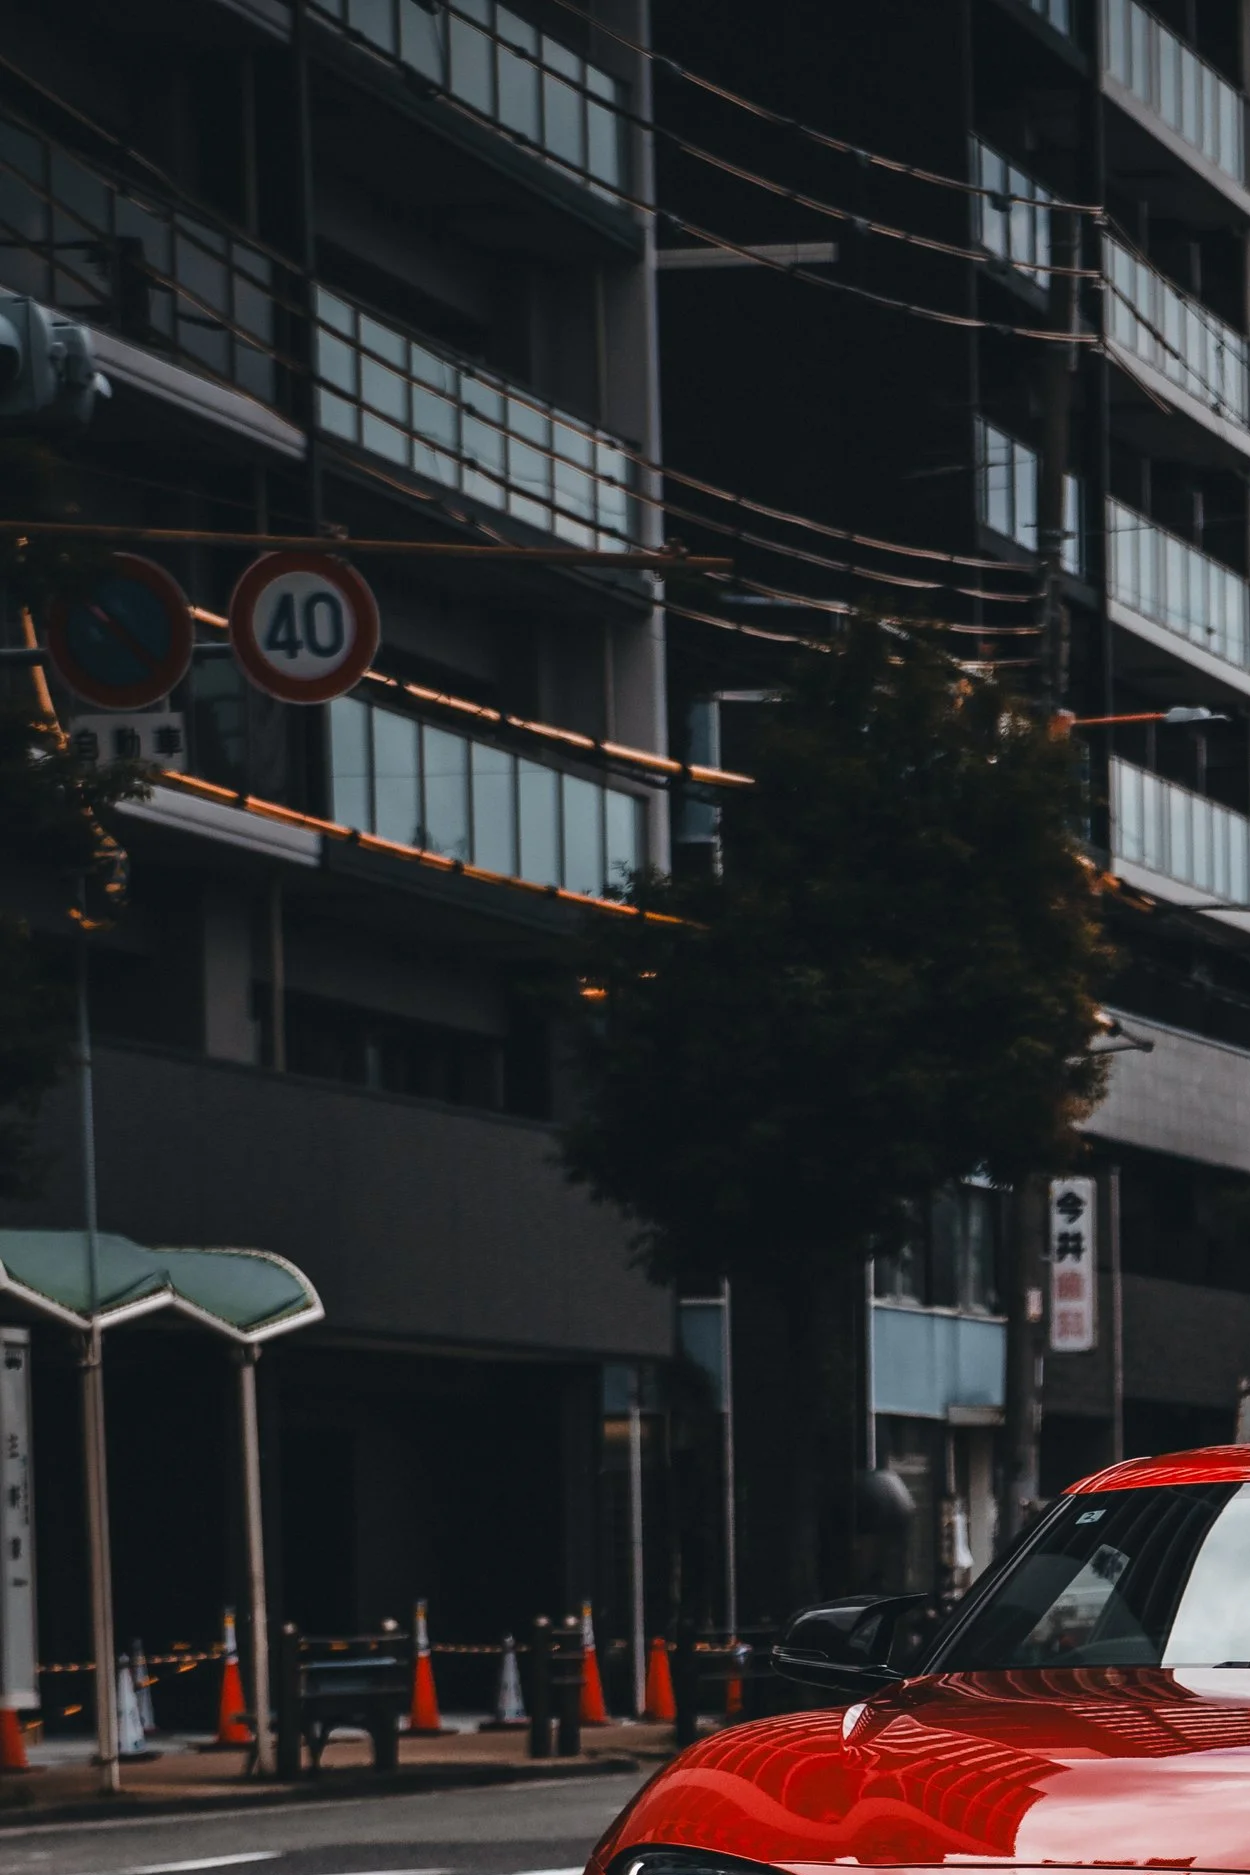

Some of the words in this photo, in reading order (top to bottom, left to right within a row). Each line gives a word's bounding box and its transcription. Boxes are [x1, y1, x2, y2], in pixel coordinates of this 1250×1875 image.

[265, 591, 345, 660] 40
[73, 724, 183, 762] 自動車
